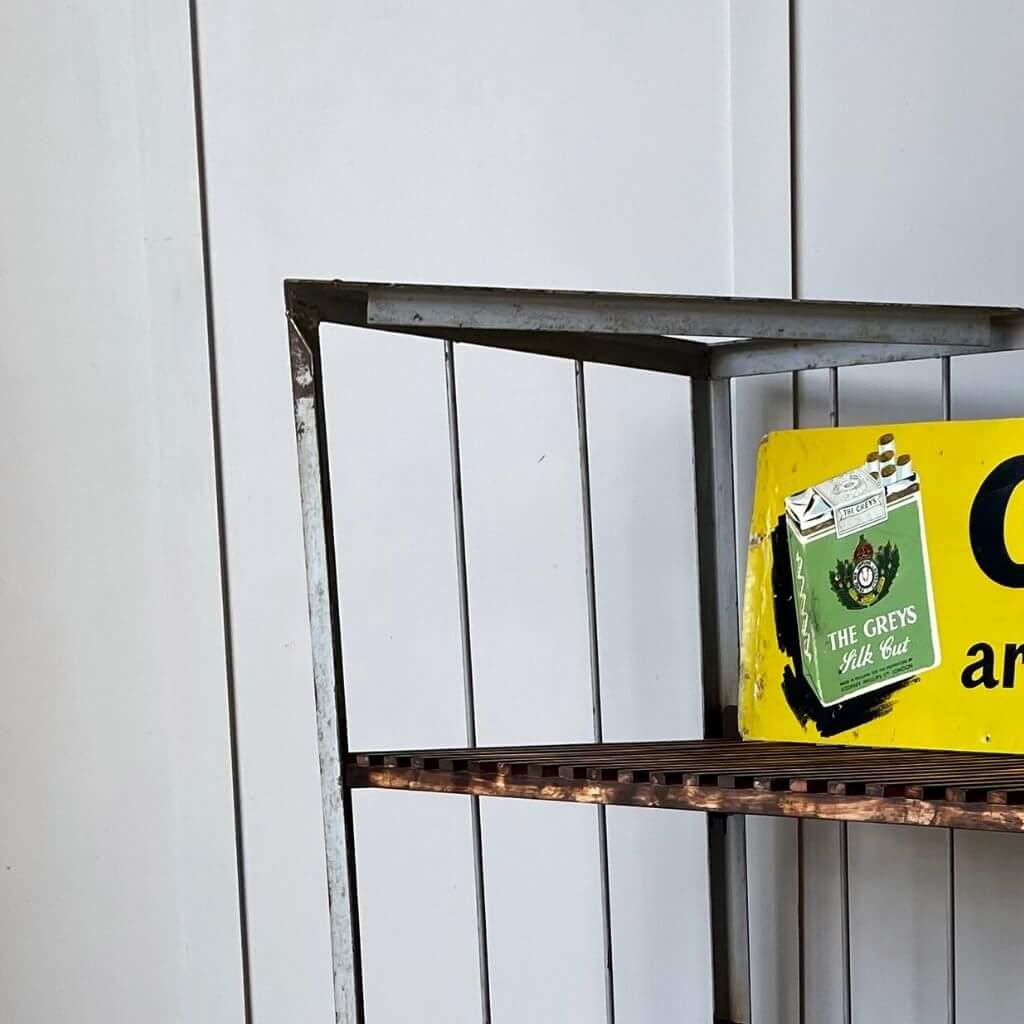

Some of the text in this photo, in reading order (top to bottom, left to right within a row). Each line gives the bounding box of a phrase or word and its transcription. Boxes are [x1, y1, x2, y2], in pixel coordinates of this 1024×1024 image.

[827, 605, 917, 651] THE GREYS
[839, 643, 874, 674] Silk
[880, 636, 911, 660] Cut
